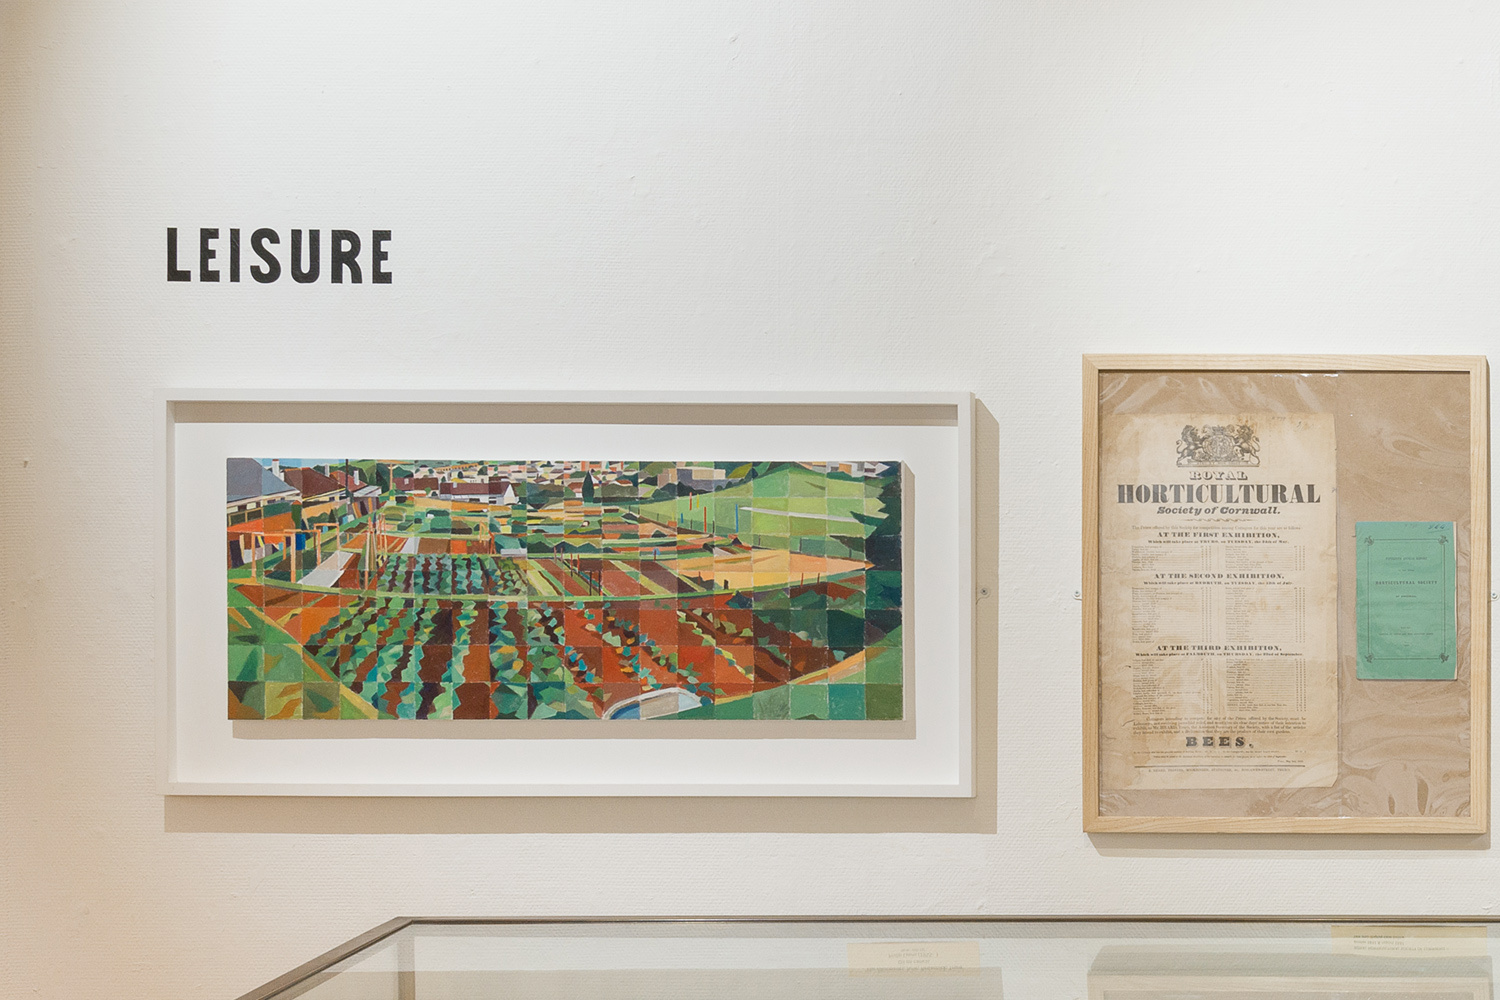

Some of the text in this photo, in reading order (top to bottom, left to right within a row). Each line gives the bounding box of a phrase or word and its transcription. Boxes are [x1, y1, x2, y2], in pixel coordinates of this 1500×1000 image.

[162, 228, 396, 284] LEISURE
[1189, 471, 1248, 481] ROYAL
[1117, 484, 1321, 504] HORTICULTURAL
[1157, 506, 1202, 516] Society
[1204, 506, 1218, 516] of
